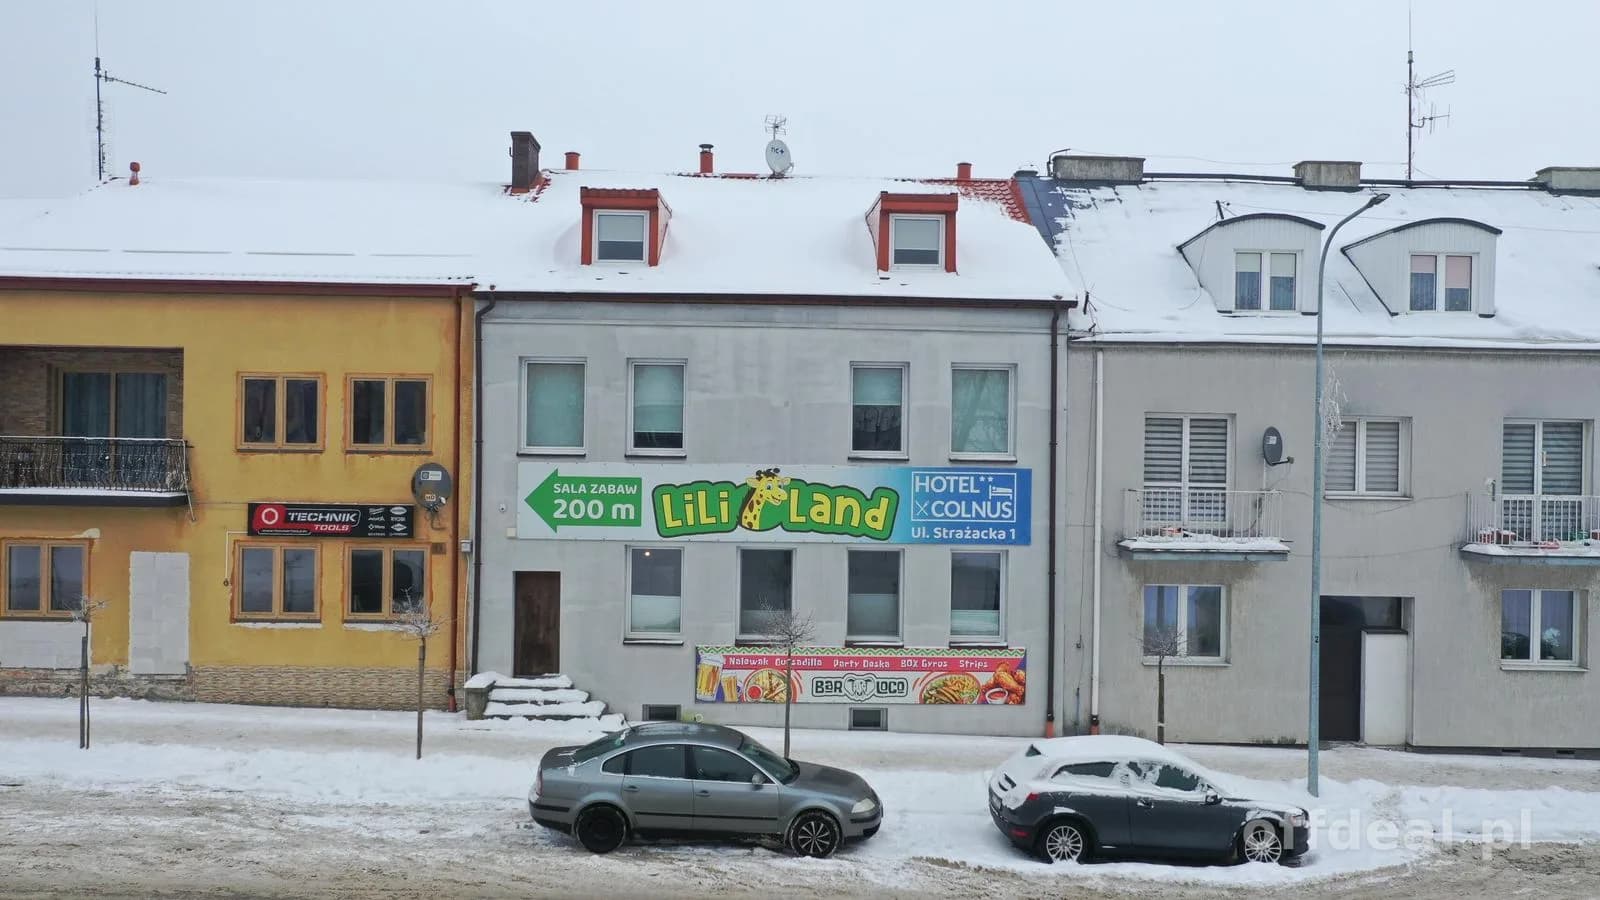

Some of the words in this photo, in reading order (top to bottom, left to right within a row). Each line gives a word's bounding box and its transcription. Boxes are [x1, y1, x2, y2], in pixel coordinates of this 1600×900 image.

[553, 483, 587, 494] SALA
[590, 484, 637, 495] ZABAW
[915, 475, 980, 493] HOTEL
[288, 512, 358, 522] TECHNIK
[553, 498, 604, 519] 200
[611, 503, 635, 520] m
[789, 488, 889, 531] Land
[931, 500, 1013, 518] COLNUS
[911, 527, 930, 539] Ul.
[933, 526, 1006, 539] Strażacka
[1010, 529, 1016, 540] 1
[775, 658, 822, 666] Qusadilla
[833, 659, 860, 668] Party
[900, 660, 918, 668] BOX
[922, 659, 948, 668] Gyros
[959, 659, 988, 669] Strips
